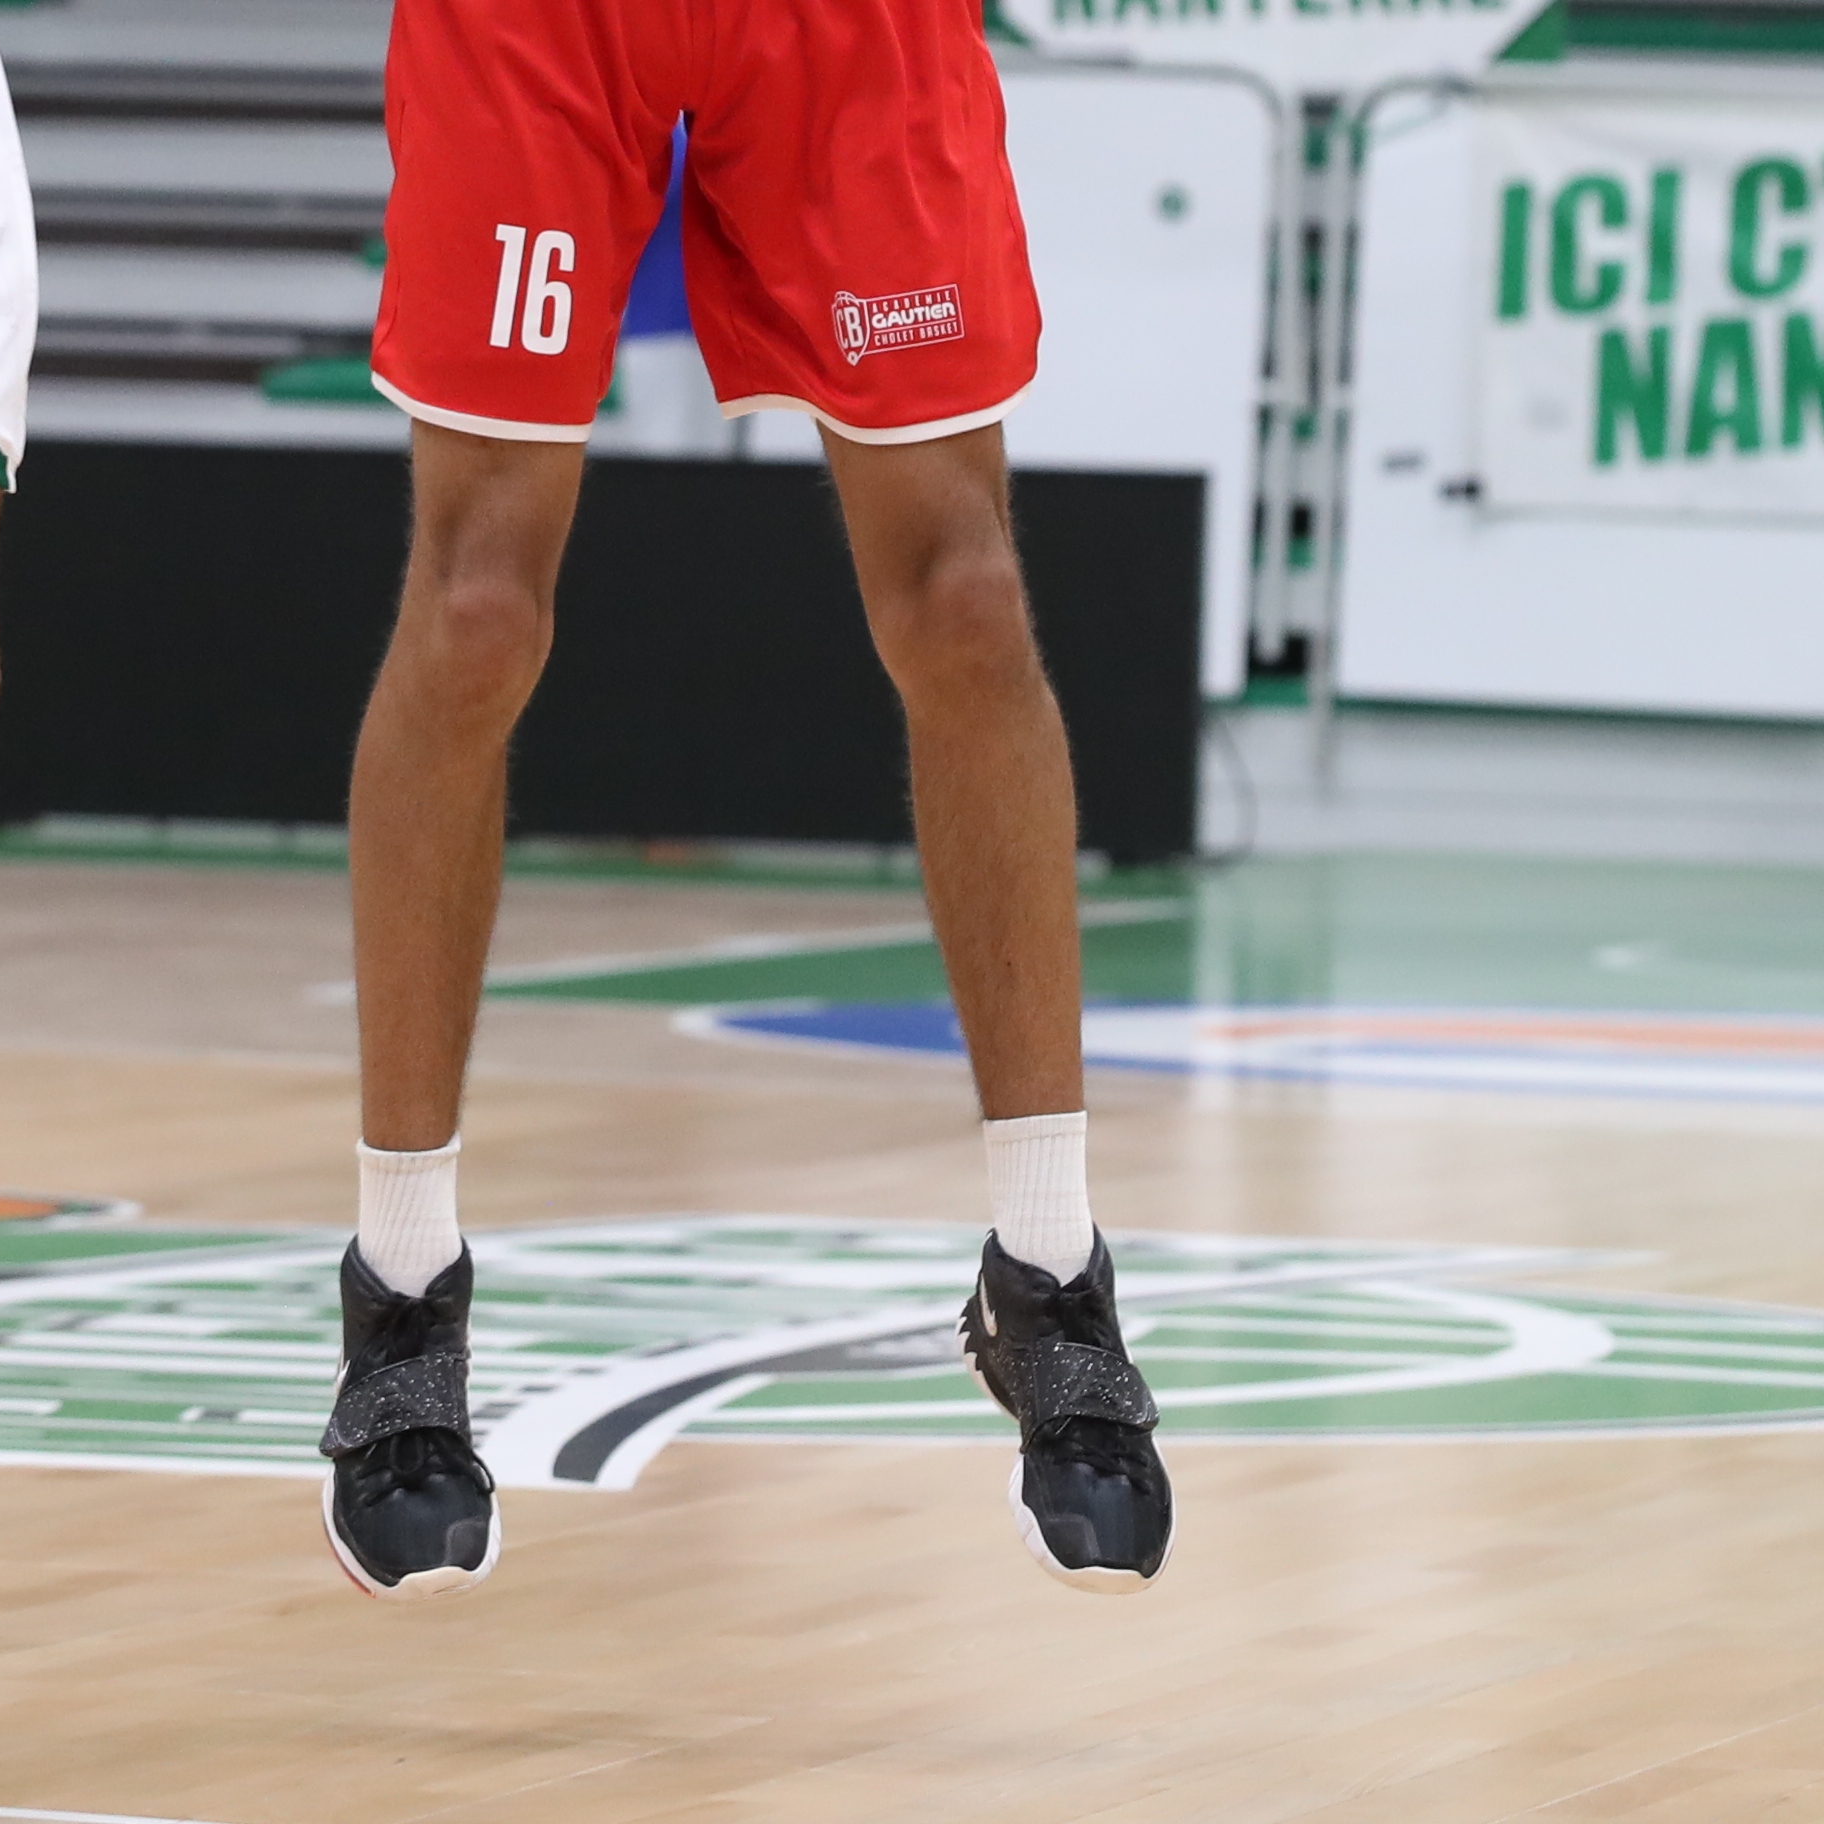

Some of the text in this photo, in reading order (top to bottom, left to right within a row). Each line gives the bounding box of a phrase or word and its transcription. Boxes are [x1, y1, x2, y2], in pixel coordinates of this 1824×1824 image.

[1496, 164, 1682, 323] ICI
[490, 223, 575, 356] 16
[872, 290, 952, 314] ACADEMIE
[871, 302, 956, 329] GAUTIER
[874, 322, 959, 347] CHOLET BASKET
